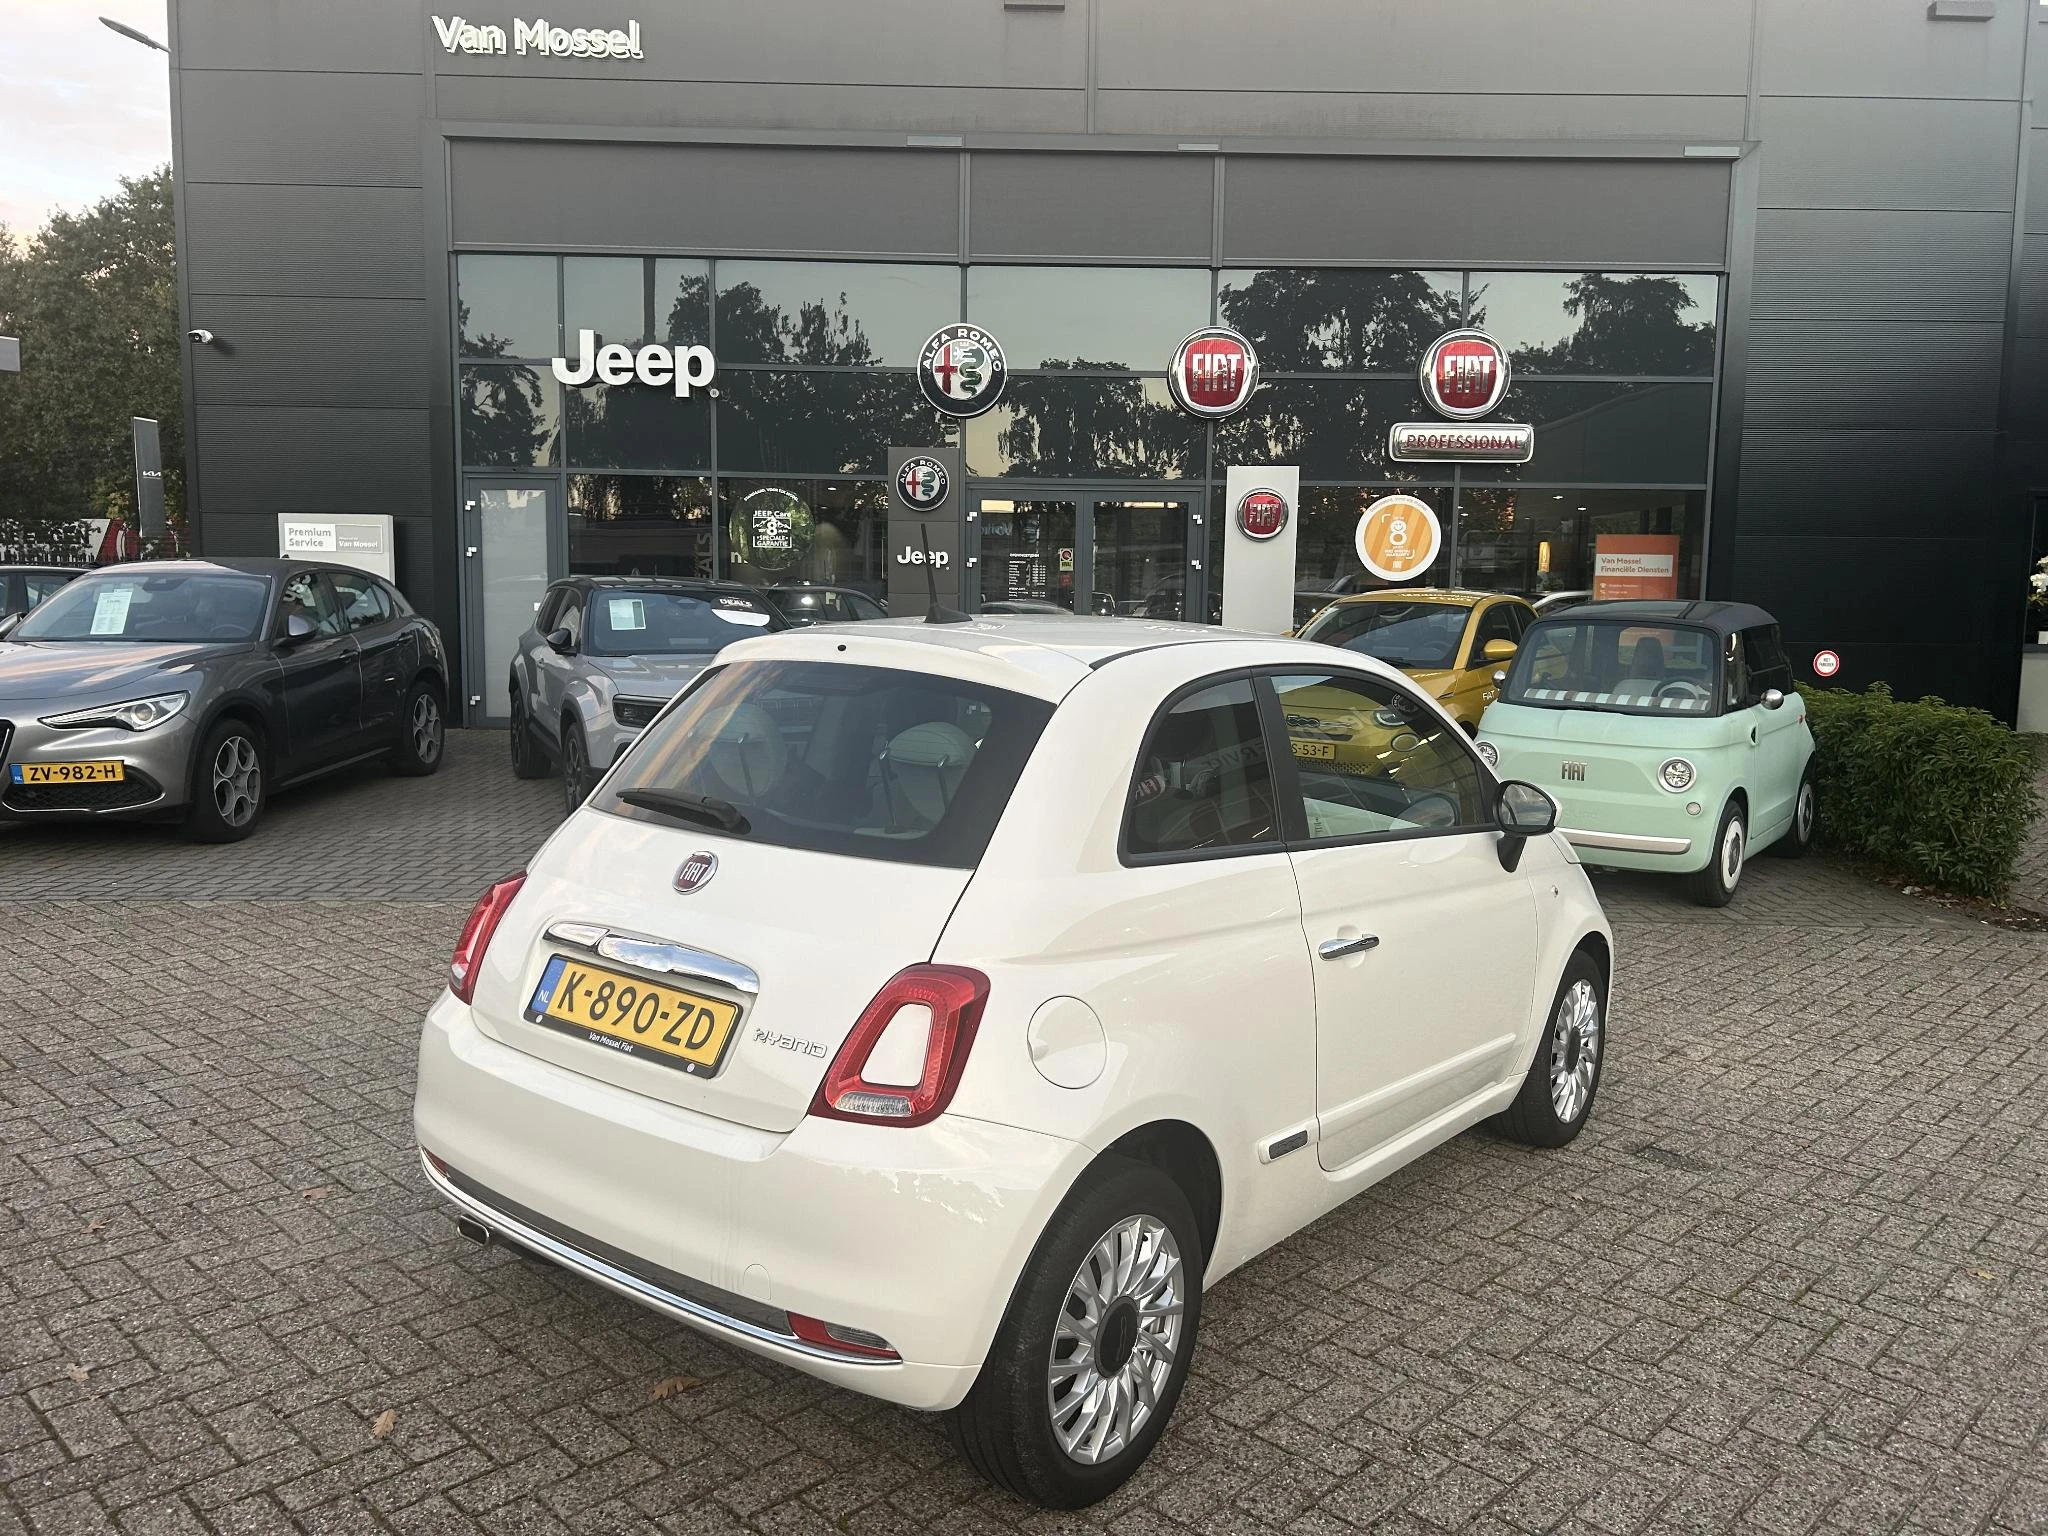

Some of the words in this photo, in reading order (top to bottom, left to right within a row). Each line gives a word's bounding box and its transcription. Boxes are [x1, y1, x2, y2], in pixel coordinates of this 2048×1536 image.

[431, 15, 507, 55] Van
[513, 17, 645, 59] Mossel
[922, 333, 951, 370] ALFA
[957, 328, 1002, 372] ROMEO
[551, 329, 715, 398] Jeep
[1192, 353, 1241, 392] FIAT
[1443, 355, 1495, 393] FIAT
[1406, 434, 1521, 450] PROFESSIONAL
[899, 462, 916, 484] ALFA
[919, 460, 946, 485] ROMEO
[1249, 503, 1280, 527] FIAT
[288, 527, 332, 537] Premium
[766, 520, 778, 536] 8
[1389, 520, 1408, 546] 8
[289, 538, 325, 548] Service
[353, 541, 378, 549] Mossel
[1616, 557, 1642, 565] Mossel
[29, 765, 116, 781] ZV-982-H
[1561, 760, 1588, 781] FIAT
[679, 861, 709, 883] FIAT
[537, 989, 550, 1003] NL
[557, 971, 716, 1050] K-890-ZD
[588, 1031, 601, 1041] Van
[599, 1035, 622, 1049] Mossel
[620, 1042, 634, 1053] Fiat
[753, 1027, 828, 1058] HYBRID
